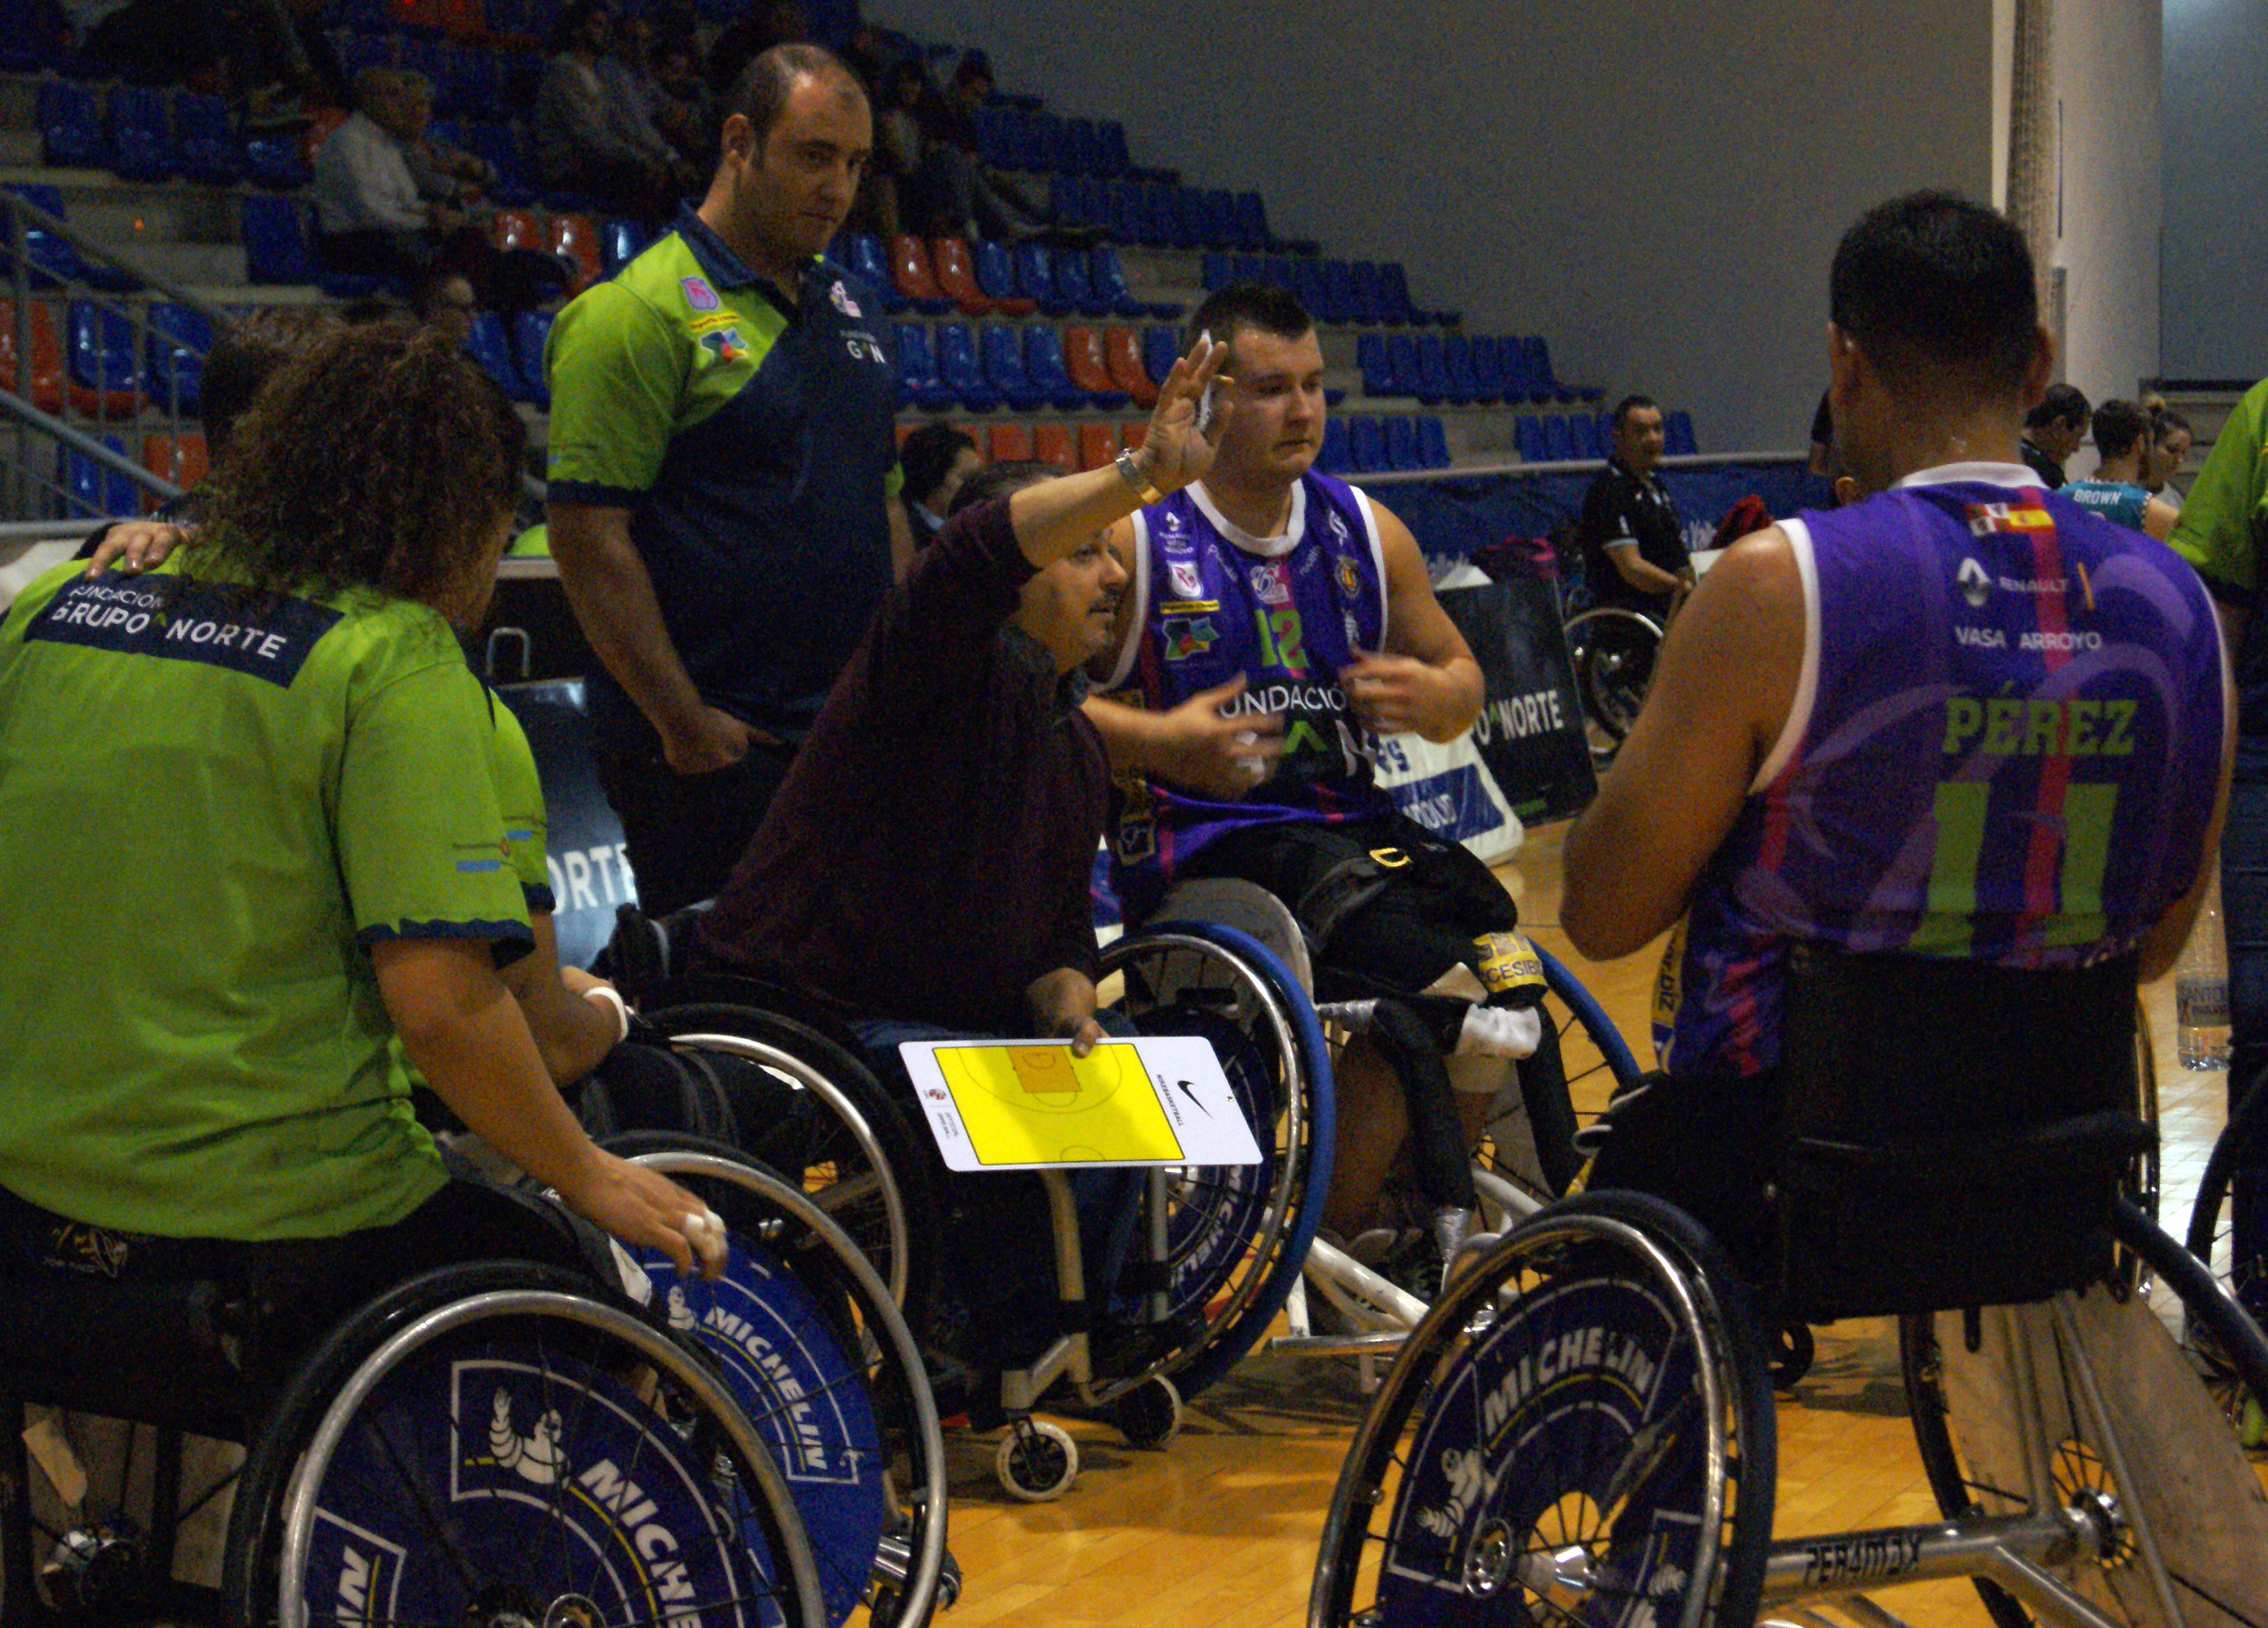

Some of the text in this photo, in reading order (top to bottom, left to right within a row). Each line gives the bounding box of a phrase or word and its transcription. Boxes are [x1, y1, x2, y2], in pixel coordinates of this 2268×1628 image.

[2073, 488, 2122, 511] BROWN
[52, 601, 287, 659] GRUPO NORTE
[1255, 608, 1310, 668] 12
[1954, 626, 2103, 651] VASA ARROYO
[1498, 690, 1565, 741] NORTE
[1941, 680, 2138, 756] PÉREZ
[1911, 781, 2119, 956] 11
[703, 1306, 828, 1470] MICHELIN
[1483, 1326, 1655, 1438] MICHELIN
